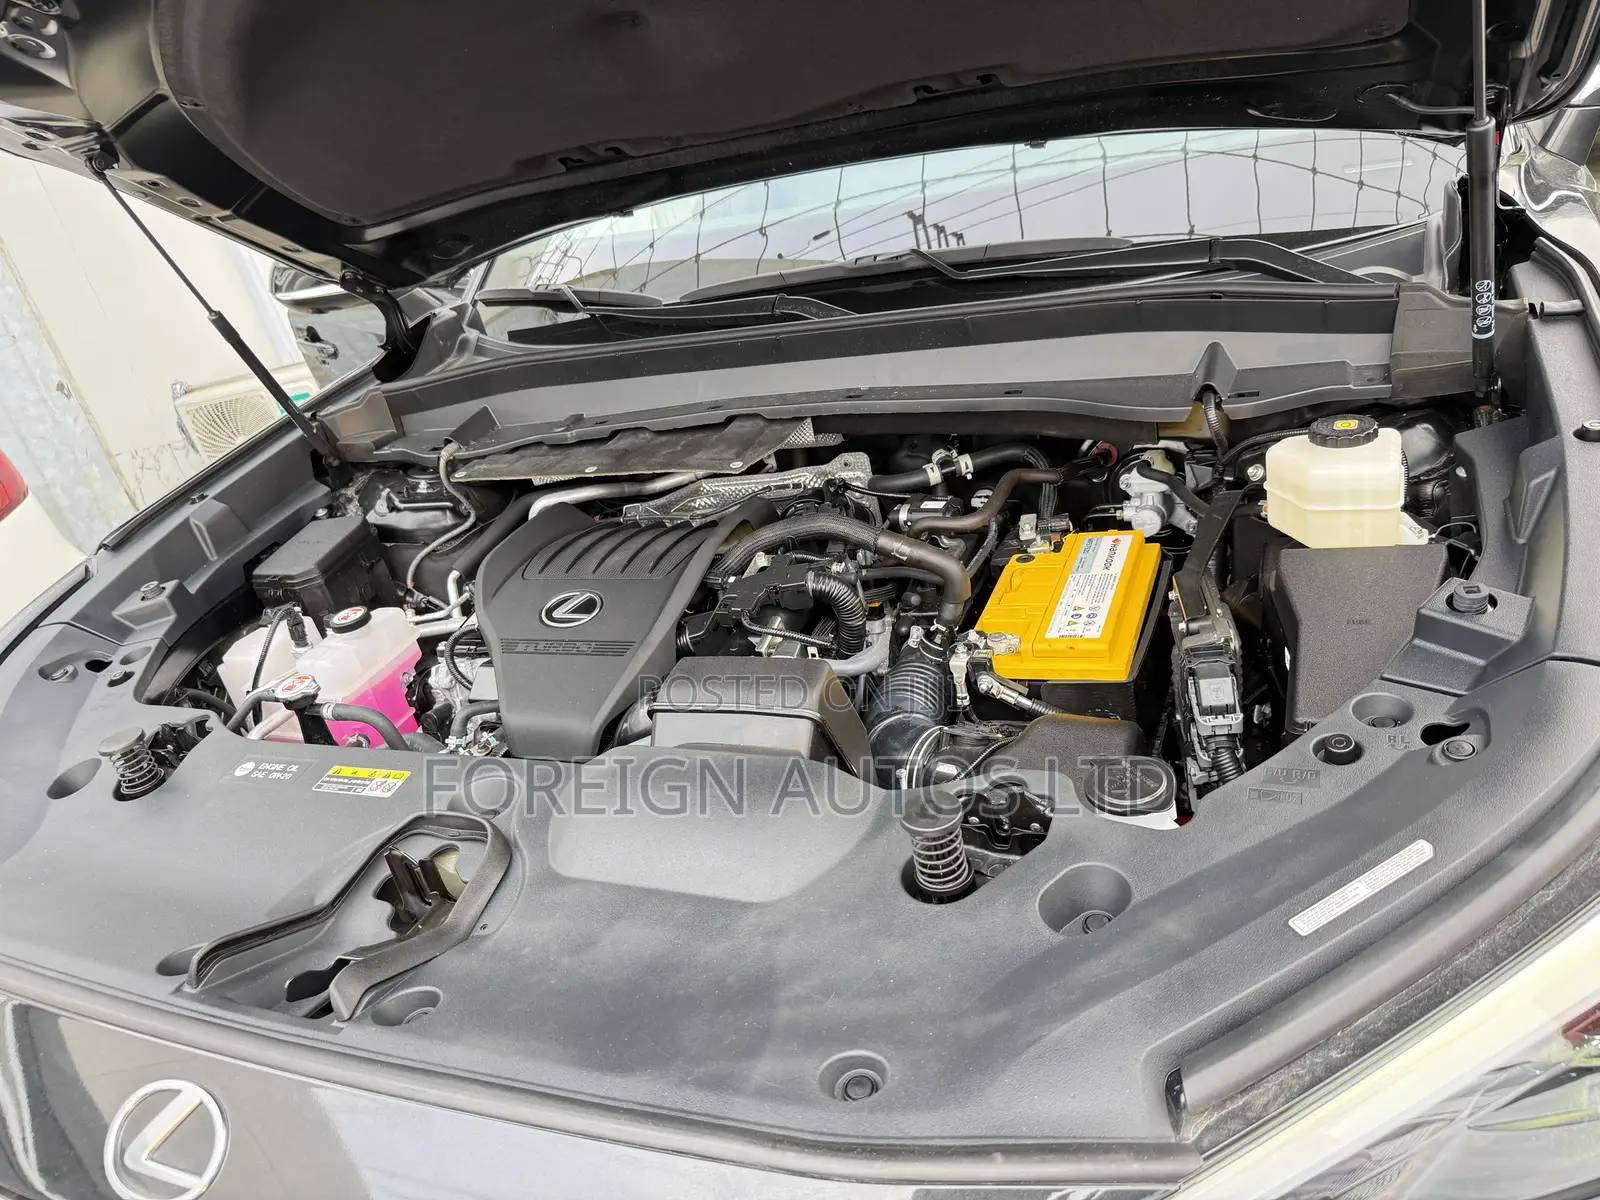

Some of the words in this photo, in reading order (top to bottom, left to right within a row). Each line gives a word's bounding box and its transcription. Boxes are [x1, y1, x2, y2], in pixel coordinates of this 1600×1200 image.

[257, 762, 287, 771] ENGINE
[286, 764, 300, 772] OIL
[250, 770, 268, 778] SAE
